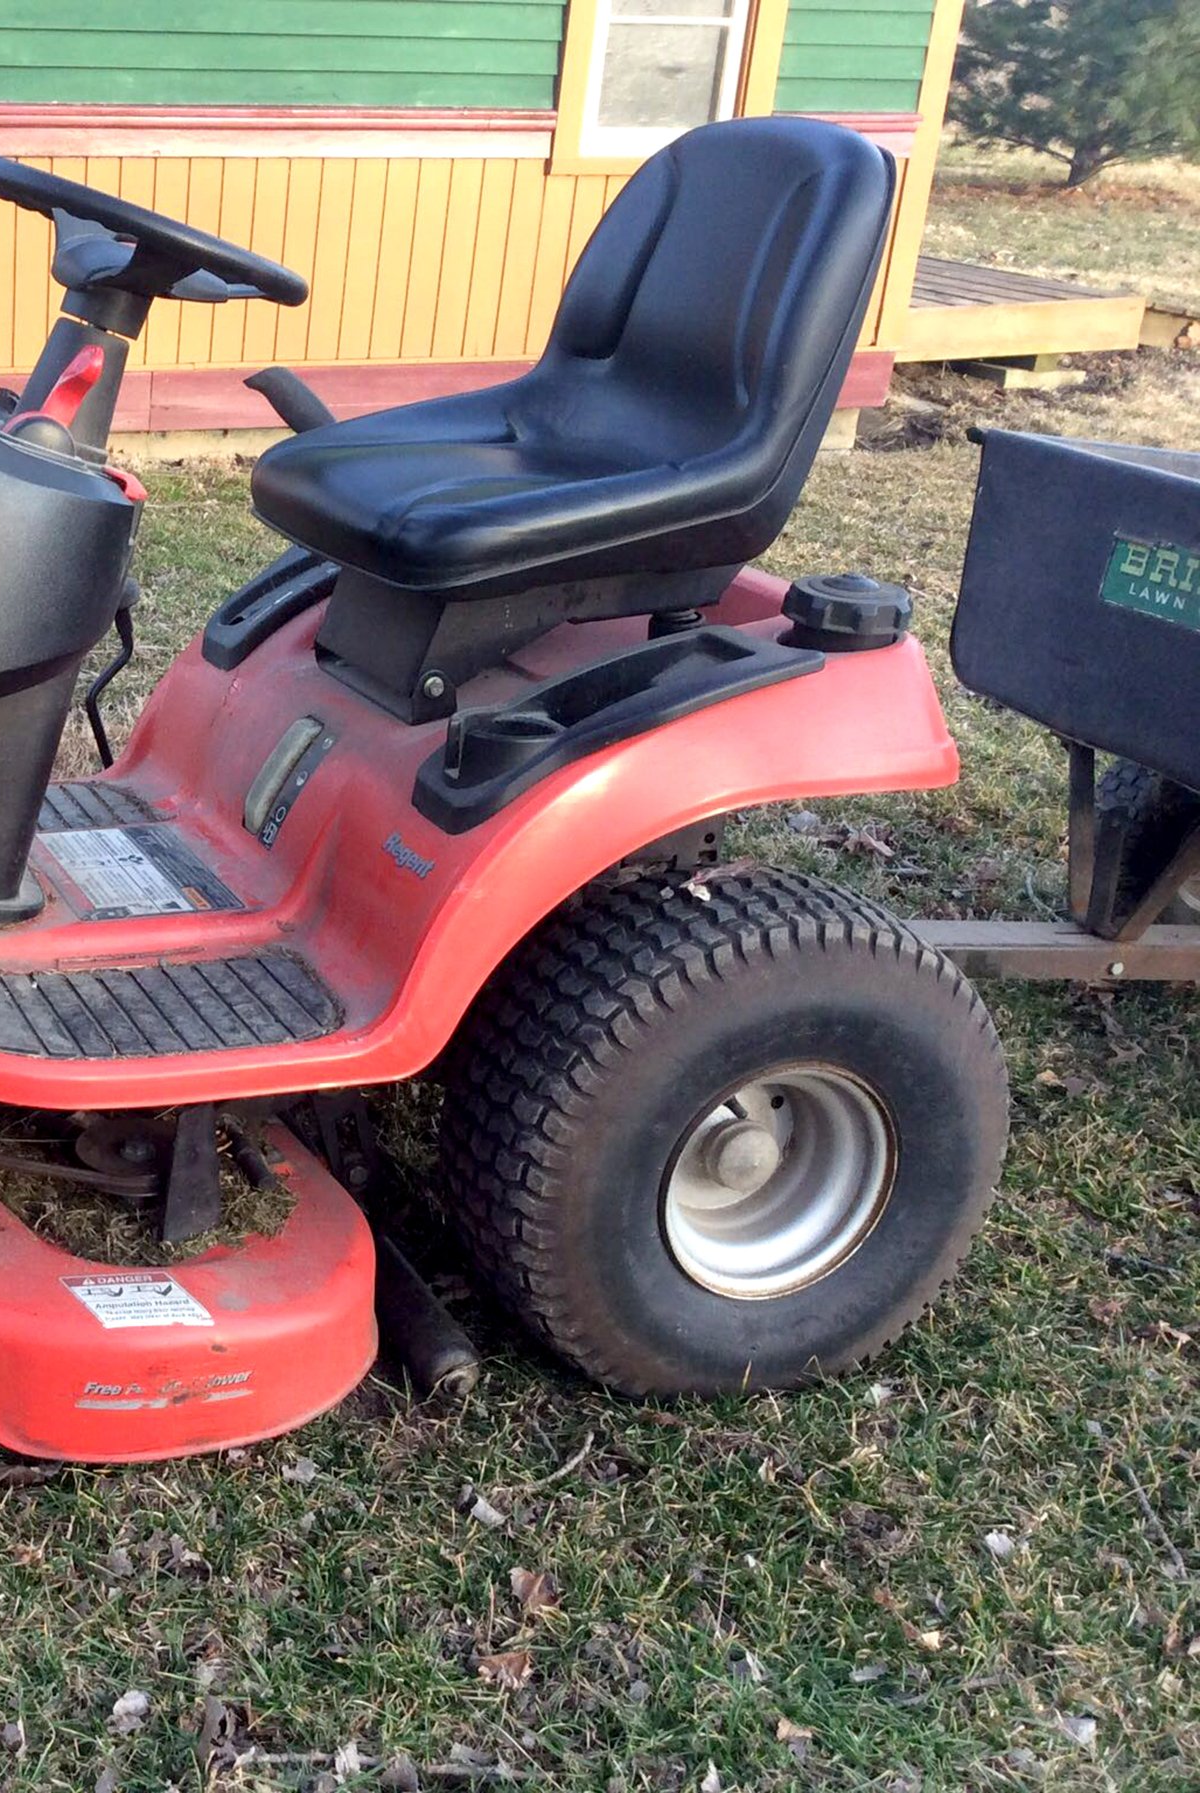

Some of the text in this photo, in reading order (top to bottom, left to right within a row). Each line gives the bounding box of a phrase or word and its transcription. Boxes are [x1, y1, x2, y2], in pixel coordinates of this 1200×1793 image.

[1120, 542, 1200, 595] BRI
[1128, 582, 1186, 610] LAWN
[382, 833, 434, 878] Regent
[97, 1274, 153, 1285] DANGER
[95, 1298, 190, 1310] Amputation Hazard
[83, 1382, 123, 1395] Free
